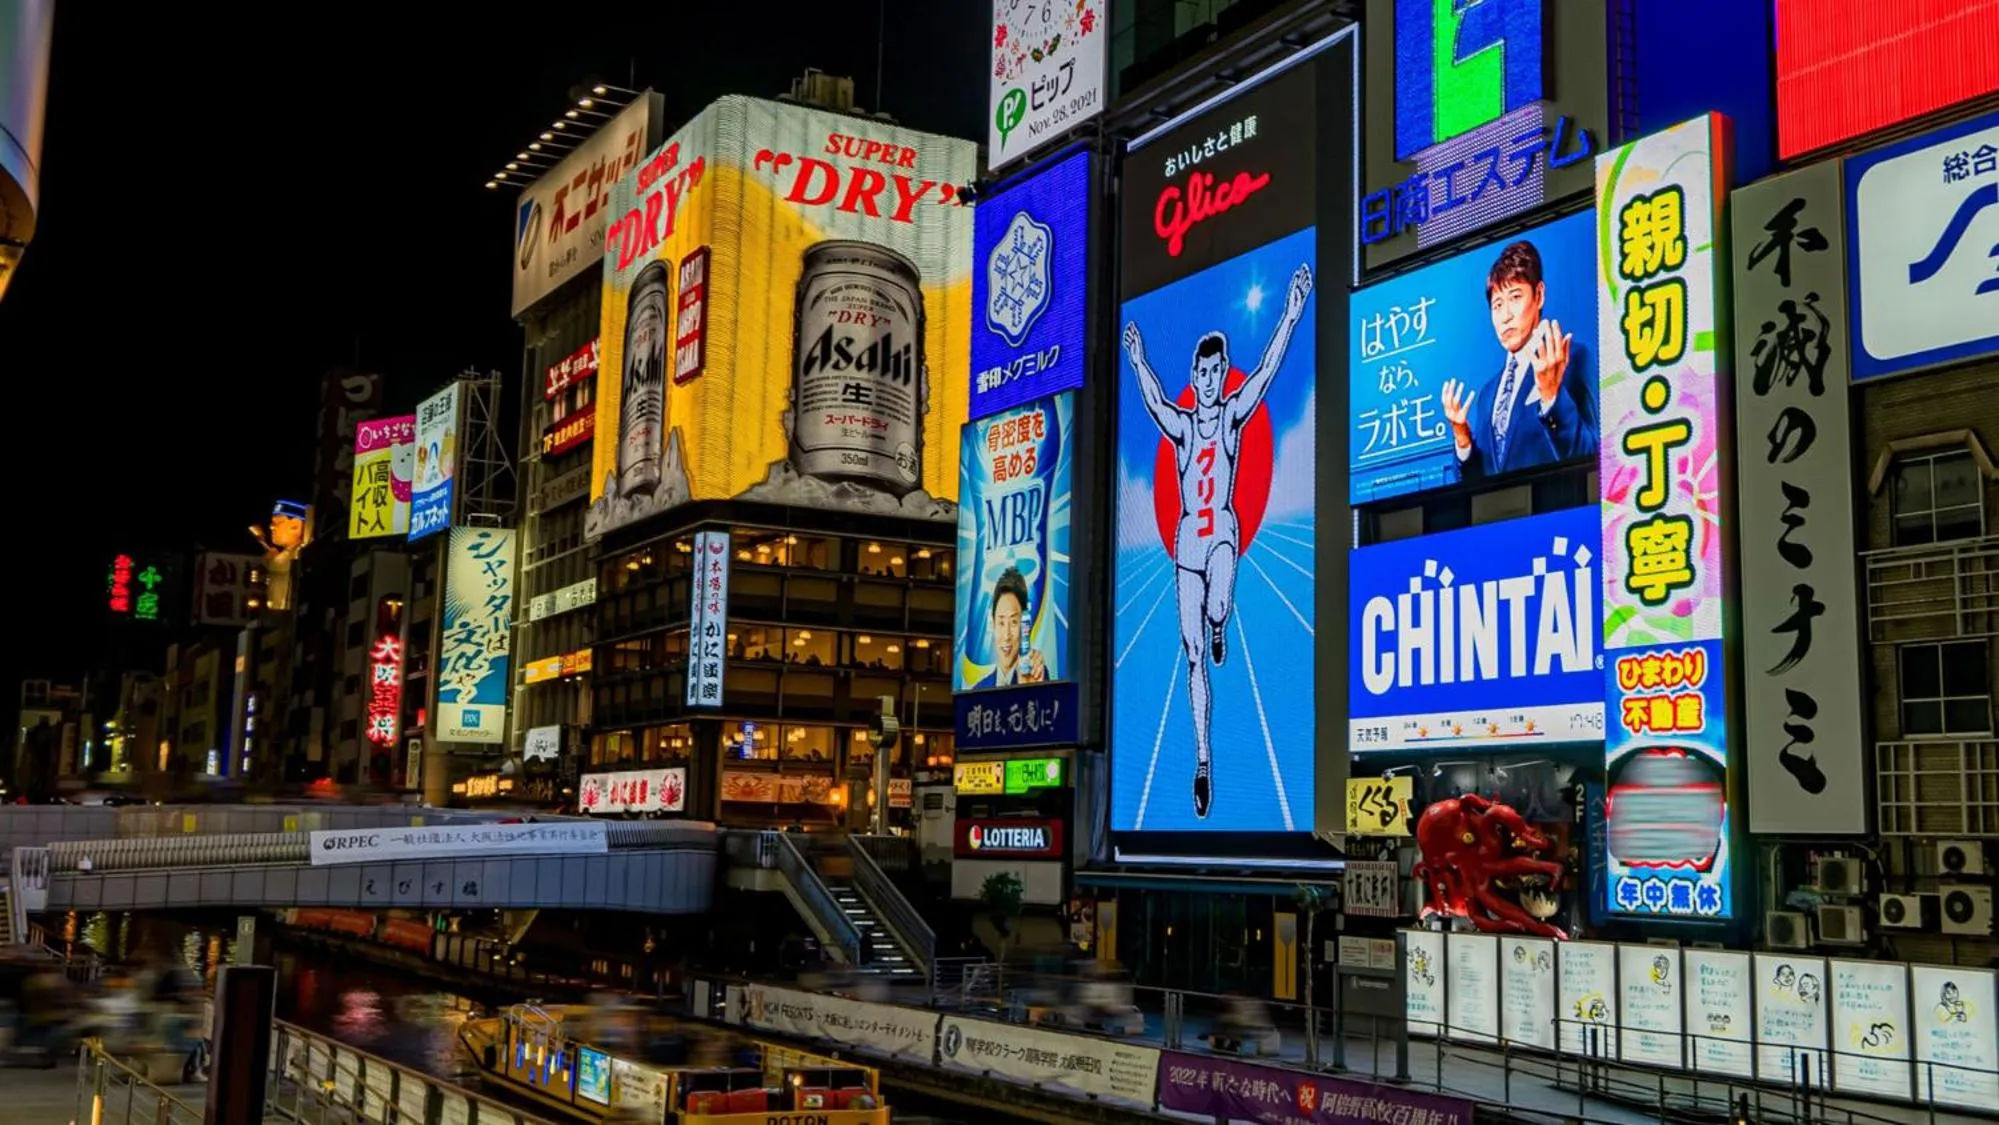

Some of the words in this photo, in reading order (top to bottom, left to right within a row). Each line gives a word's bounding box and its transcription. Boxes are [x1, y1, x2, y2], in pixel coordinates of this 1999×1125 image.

[1031, 57, 1076, 111] ピップ
[1029, 120, 1051, 138] Nov.
[1070, 88, 1097, 115] 2021
[636, 141, 680, 196] SUPER
[825, 132, 917, 169] SUPER
[1165, 115, 1258, 177] おいしさと健康
[1943, 143, 1999, 184] 総合
[1362, 114, 1593, 245] 日商エステム
[1361, 296, 1437, 358] はやす
[803, 324, 911, 387] Asahi
[976, 345, 1060, 394] 雪印メグミルク
[1379, 359, 1419, 394] なら、
[841, 383, 873, 406] 生
[1619, 184, 1695, 607] 親切・丁寧
[824, 414, 889, 431] スーパードライ
[987, 411, 1044, 452] 骨密度を
[1357, 394, 1447, 453] ラボモ。
[841, 452, 869, 467] 350ml
[993, 446, 1037, 484] 高める
[355, 463, 373, 534] バイト
[370, 459, 391, 533] 高収入
[1196, 440, 1217, 538] グリコ
[985, 487, 1042, 550] MBP
[467, 531, 511, 655] シャッターは
[1362, 553, 1594, 695] CHINTAI
[702, 621, 721, 700] かに道楽
[1617, 649, 1707, 692] ひまわり
[367, 635, 402, 743] 大阪王将
[1622, 693, 1705, 734] 不動産
[1356, 726, 1389, 743] 天気予報
[610, 778, 649, 805] かに道楽
[1358, 785, 1399, 828] くくる
[983, 828, 1045, 848] LOTTERIA
[365, 878, 478, 897] えびす橋
[1617, 877, 1722, 915] 年中無休
[1168, 1065, 1209, 1086] 2022年
[1212, 1071, 1293, 1104] 新たな時代へ
[1299, 1084, 1316, 1110] 祝
